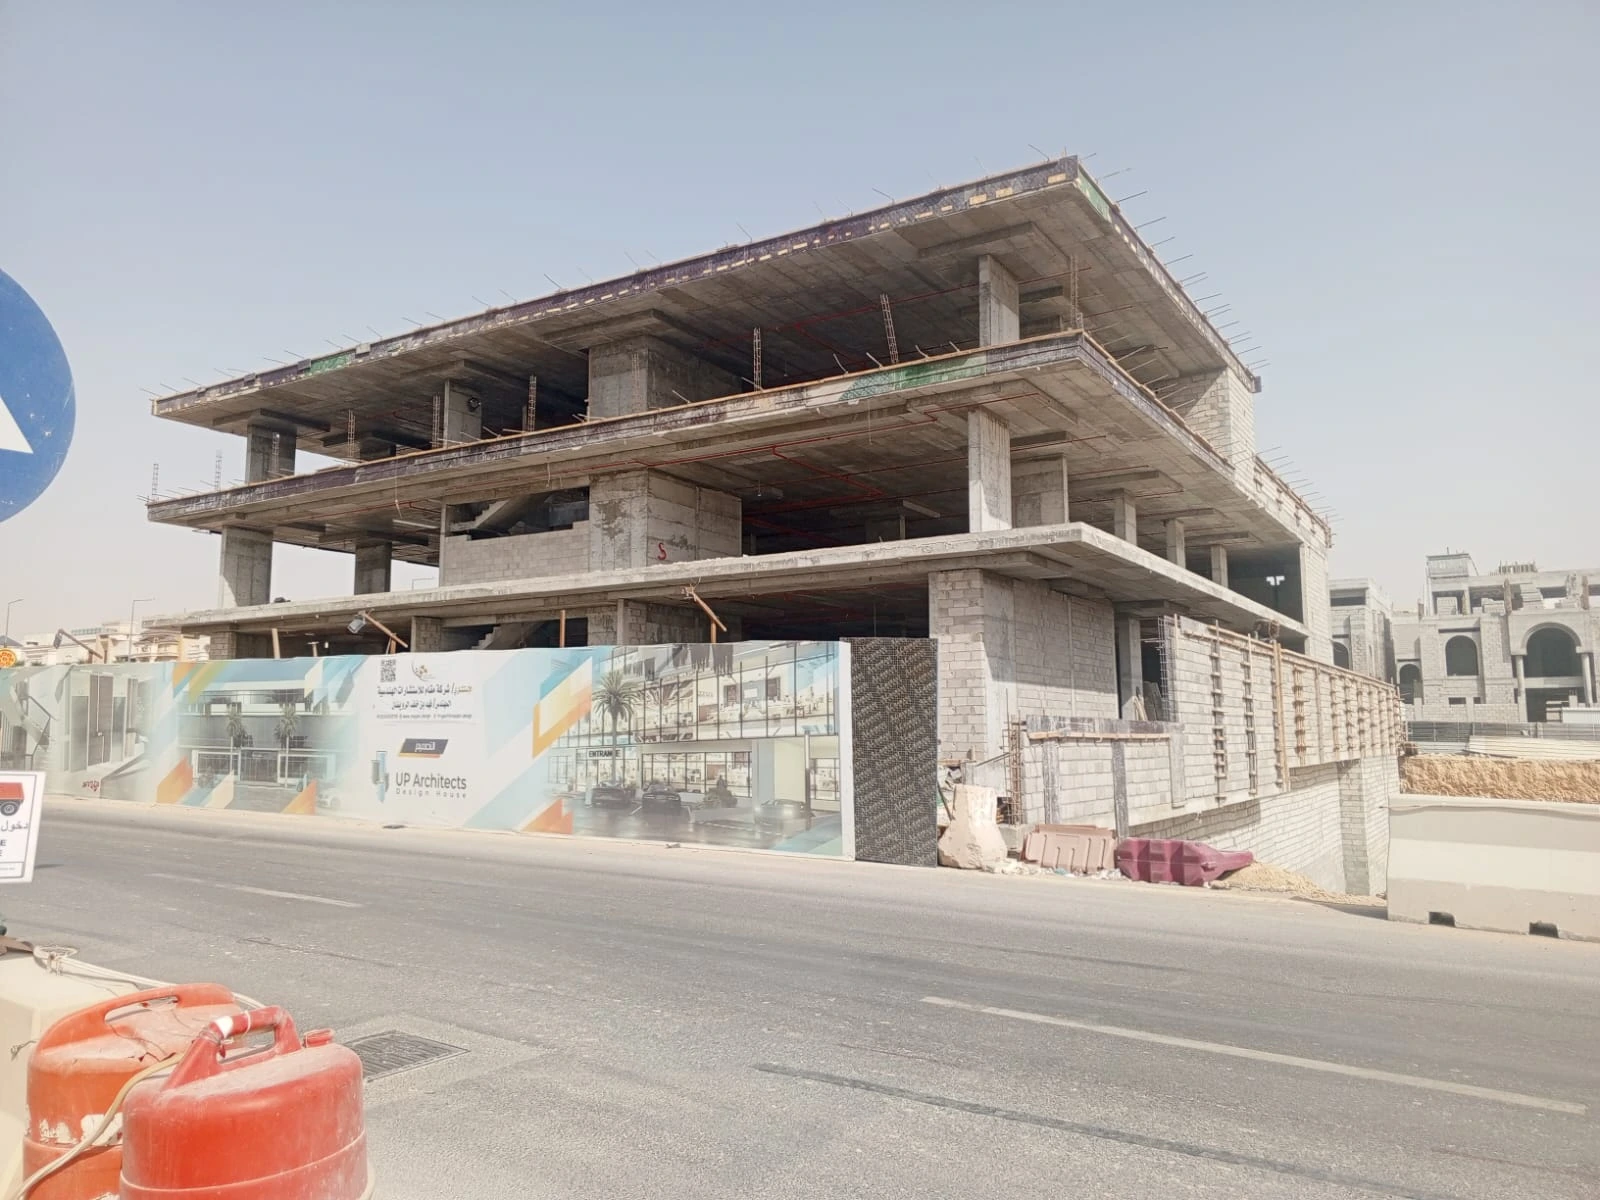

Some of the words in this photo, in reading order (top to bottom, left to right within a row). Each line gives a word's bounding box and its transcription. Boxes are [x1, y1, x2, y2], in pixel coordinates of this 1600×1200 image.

[588, 749, 621, 758] ENTRANE
[396, 772, 411, 787] UP
[413, 772, 467, 790] Architects
[396, 788, 430, 797] Design
[436, 790, 467, 799] House
